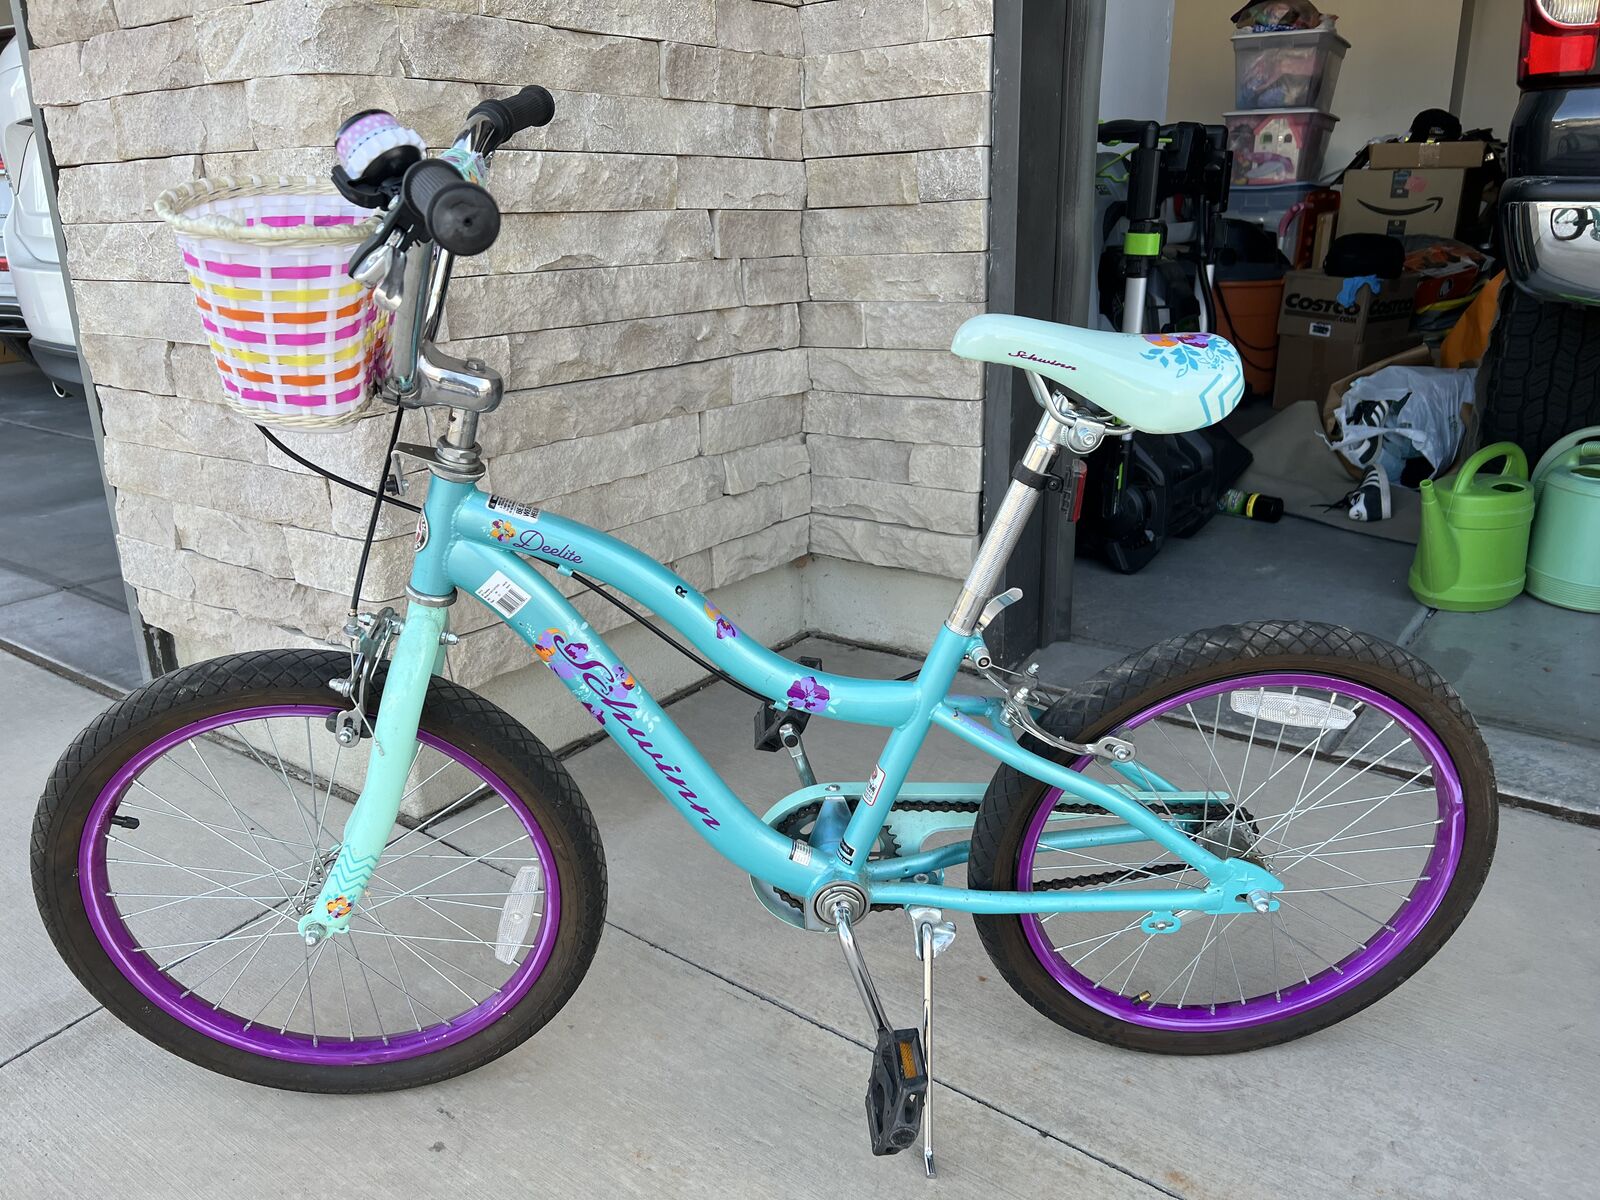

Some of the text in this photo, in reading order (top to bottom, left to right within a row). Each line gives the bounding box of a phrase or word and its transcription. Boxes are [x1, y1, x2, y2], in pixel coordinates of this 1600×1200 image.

[1008, 350, 1077, 371] Schwinn
[513, 530, 582, 563] Deelite
[553, 634, 721, 831] Schwinn
